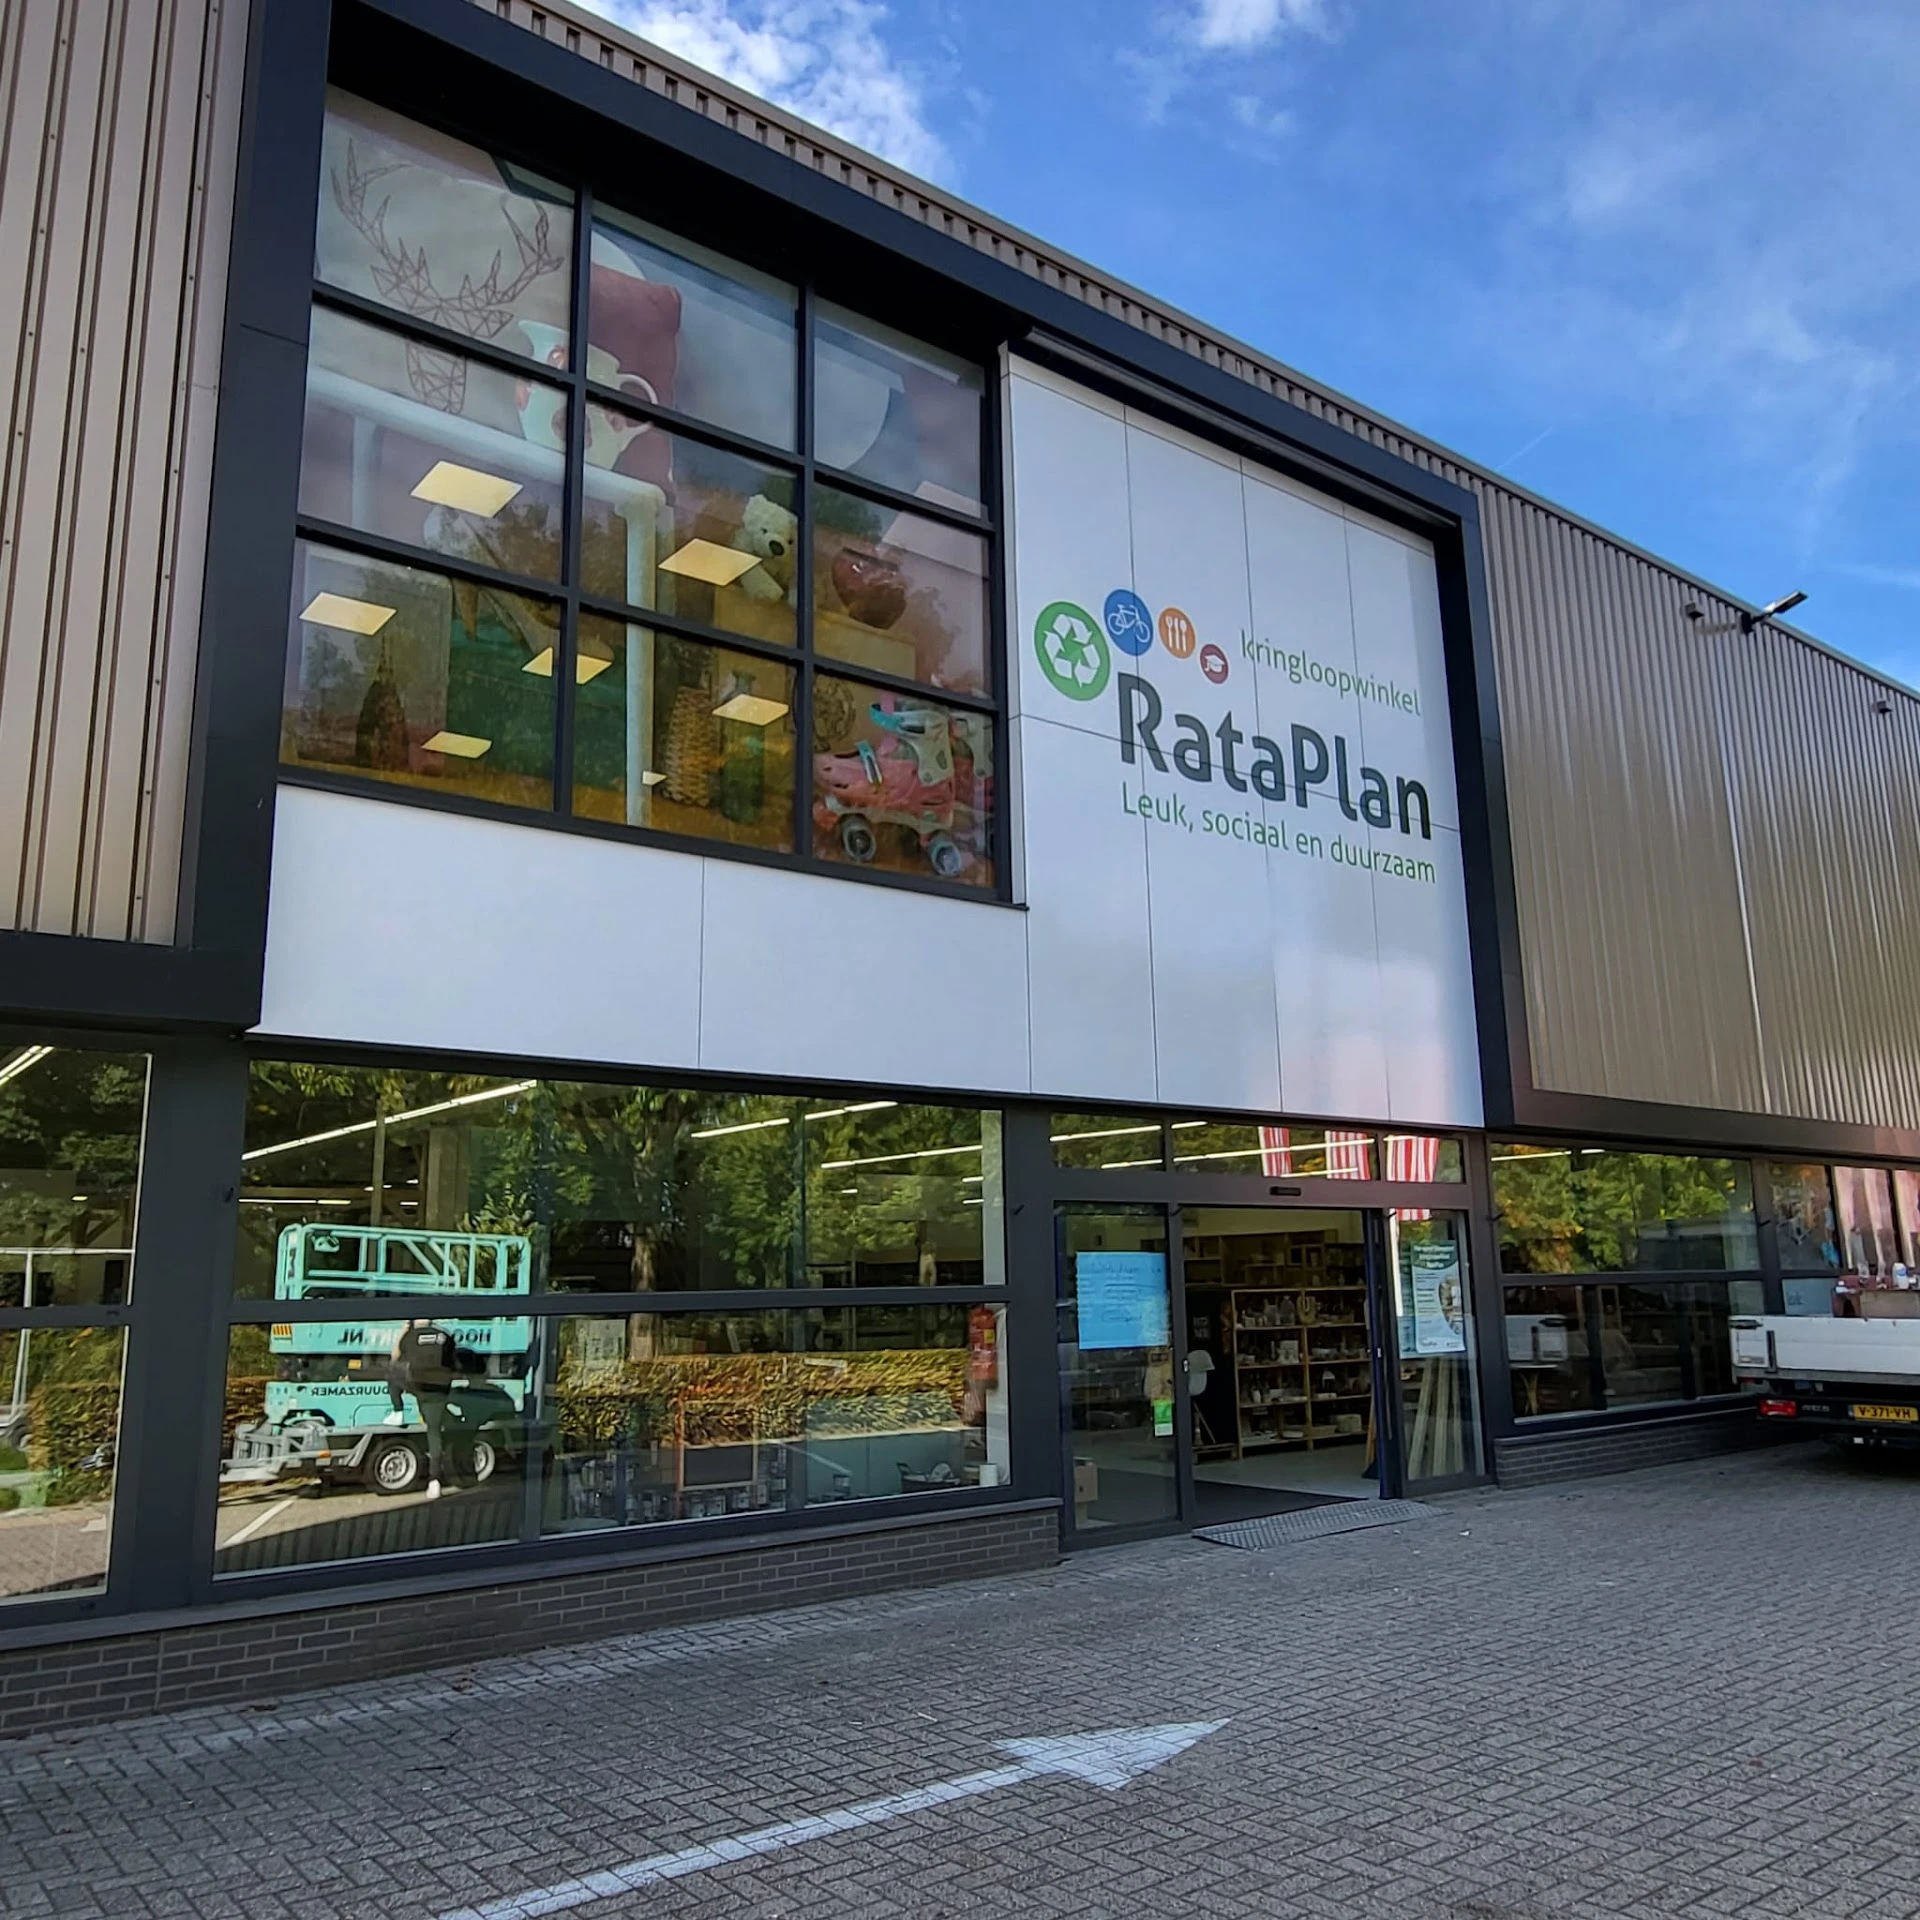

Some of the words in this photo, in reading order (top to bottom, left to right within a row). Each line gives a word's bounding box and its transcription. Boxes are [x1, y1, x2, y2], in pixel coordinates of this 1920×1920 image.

[1117, 671, 1432, 841] RataPlan
[1122, 781, 1194, 833] Leuk,
[1202, 808, 1289, 851] sociaal
[1296, 834, 1323, 859] en
[1330, 834, 1437, 884] duurzaam
